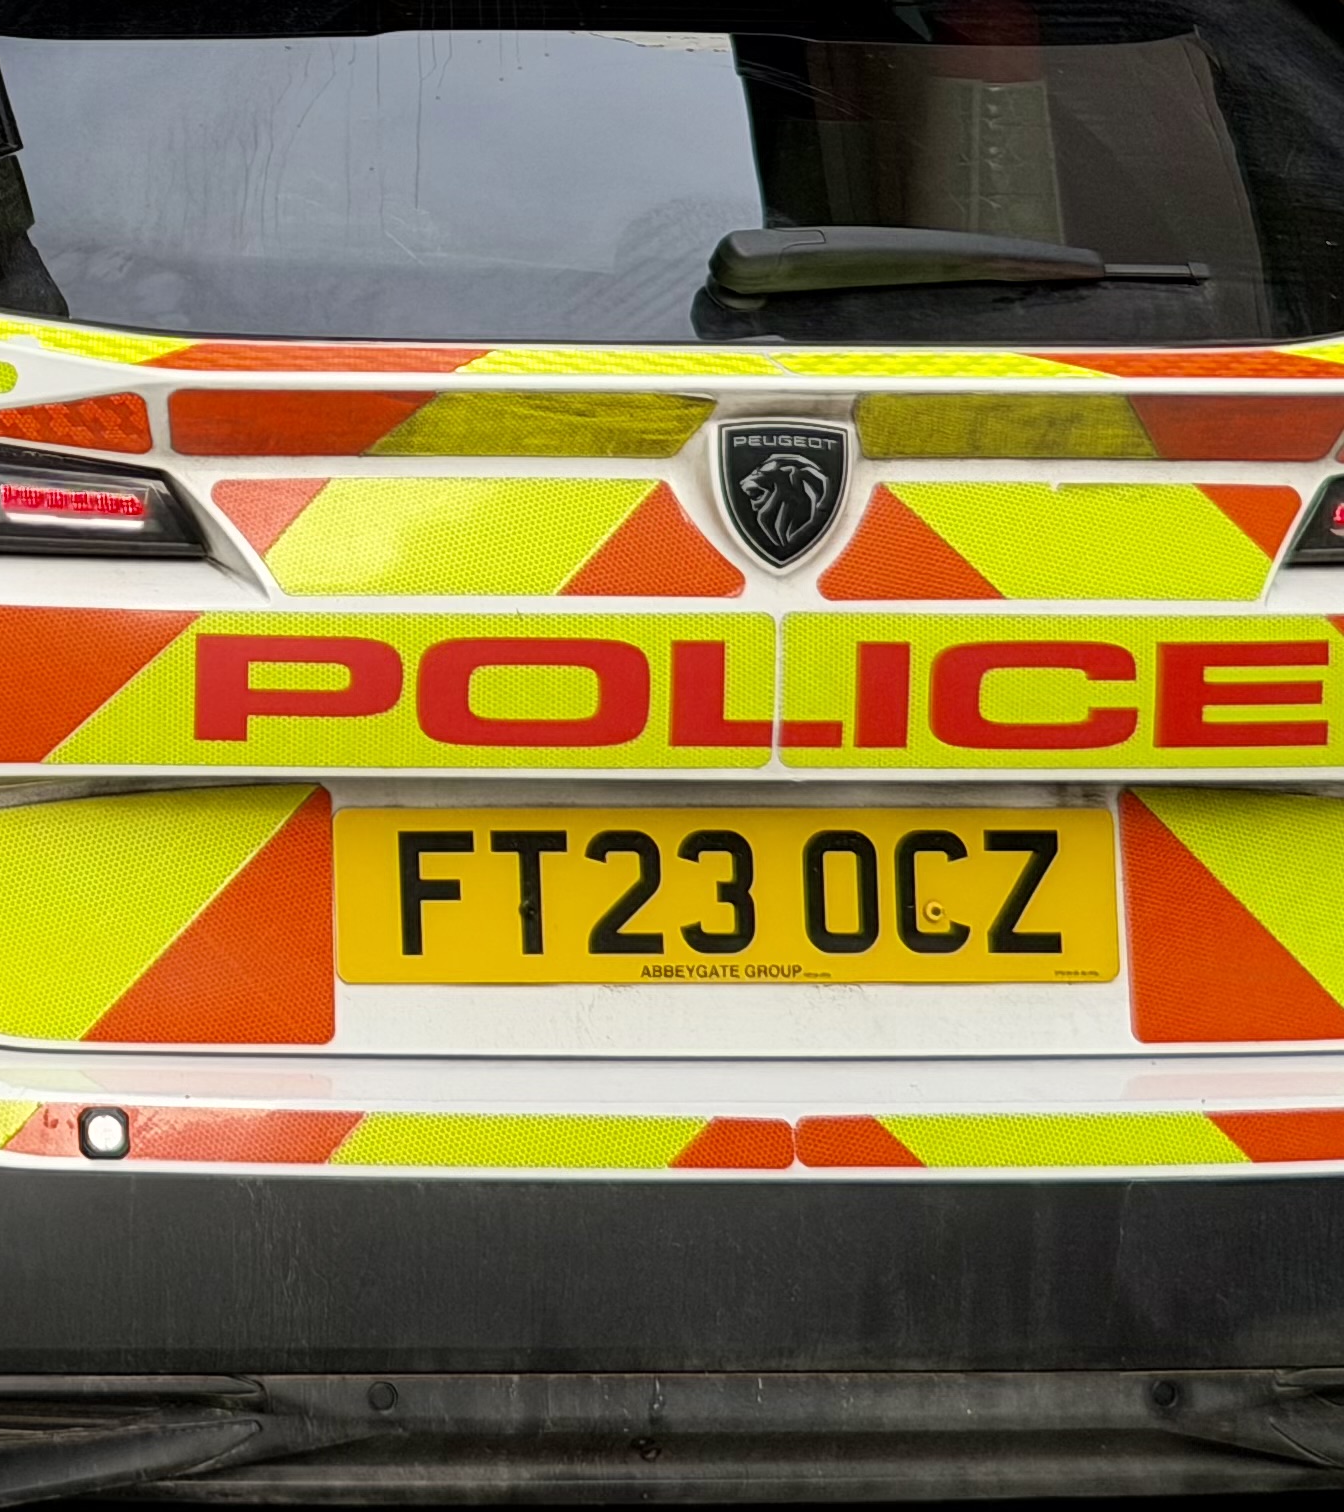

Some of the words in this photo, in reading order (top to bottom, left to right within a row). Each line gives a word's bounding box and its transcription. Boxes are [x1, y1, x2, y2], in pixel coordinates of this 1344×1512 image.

[733, 435, 839, 451] PEUGEOT
[194, 633, 1330, 750] POLICE
[398, 830, 755, 955] FT23
[803, 830, 1062, 954] OCZ
[641, 964, 740, 978] ABBEYGATE
[745, 964, 803, 978] GROUP
